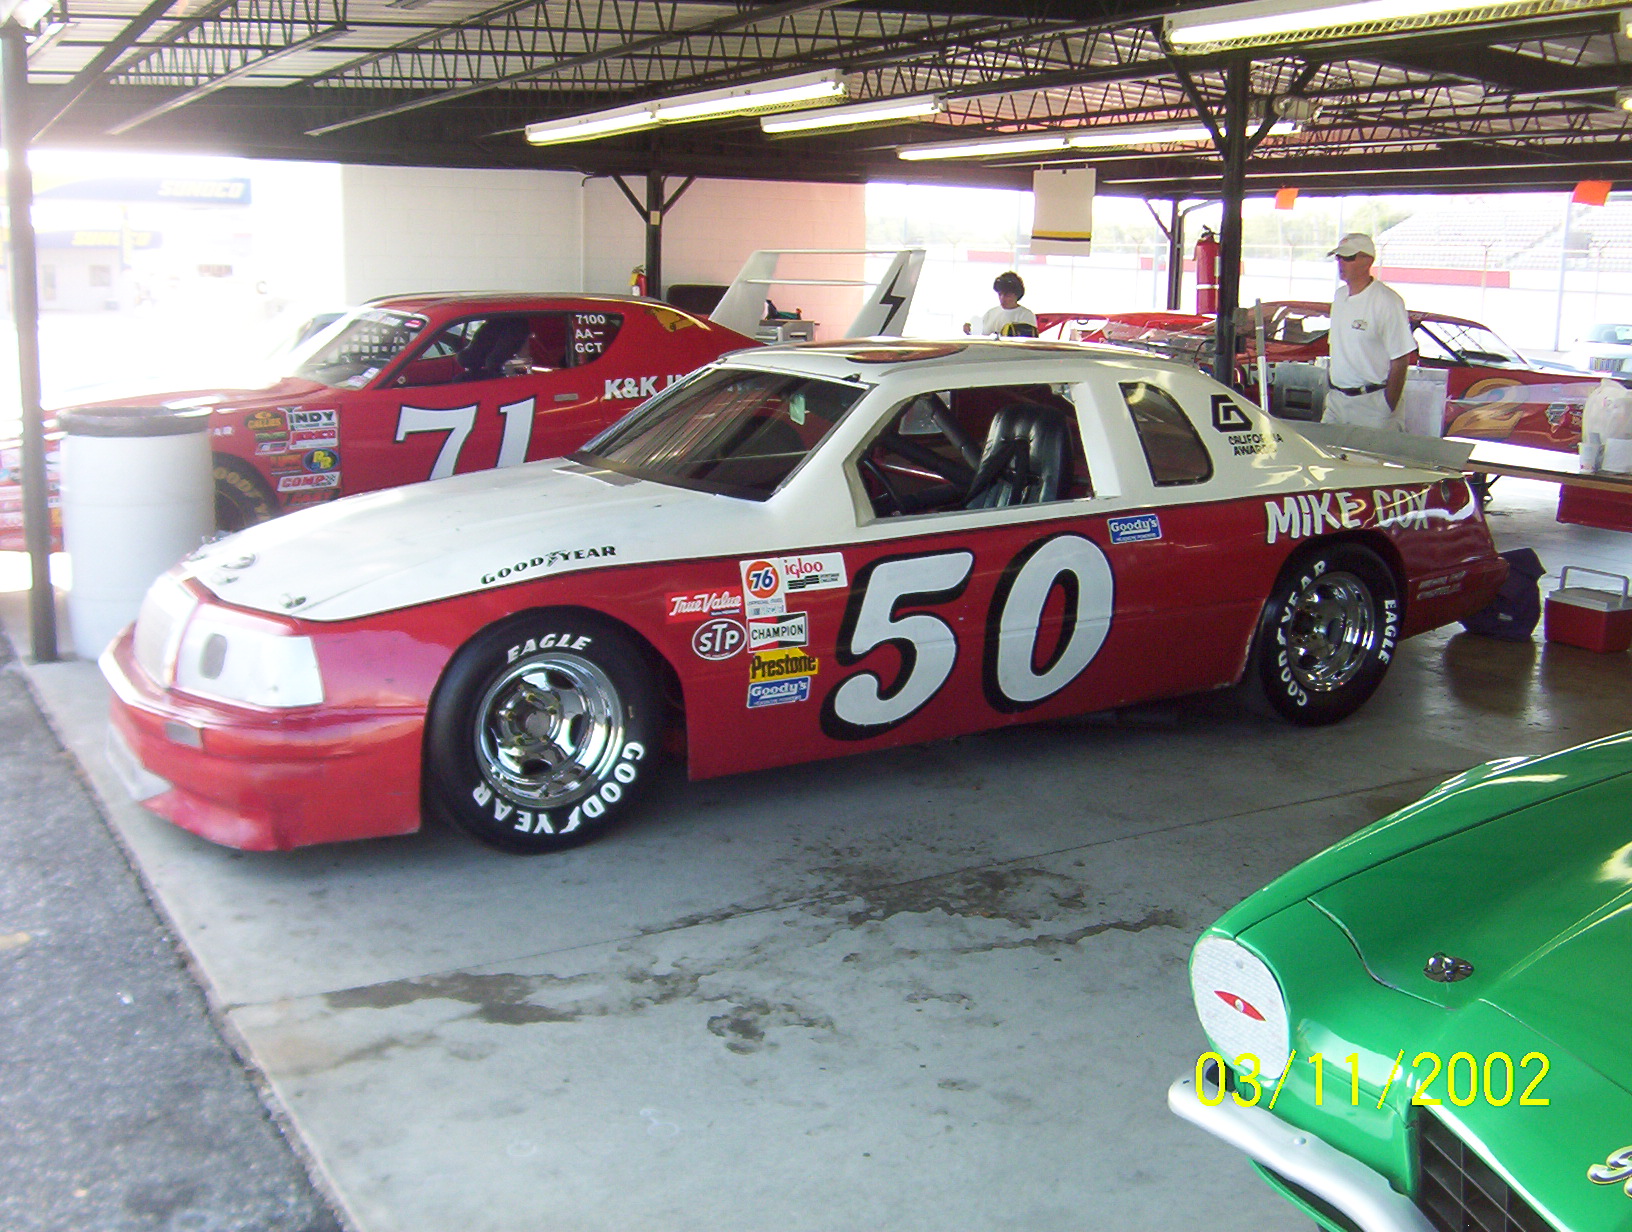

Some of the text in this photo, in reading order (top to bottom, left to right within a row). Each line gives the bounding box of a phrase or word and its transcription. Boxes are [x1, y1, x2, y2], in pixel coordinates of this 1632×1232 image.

[157, 180, 245, 198] SUNOCO
[575, 314, 606, 324] 7100
[575, 342, 603, 353] GCT
[604, 376, 658, 400] K&K
[287, 408, 335, 425] INDY
[395, 395, 536, 481] 71
[1228, 433, 1284, 446] CALIFORIA
[282, 475, 326, 488] COMP
[1373, 489, 1428, 530] COX
[1110, 518, 1158, 535] Goody's
[481, 545, 617, 585] GOODYEAR
[784, 557, 823, 578] igloo
[750, 567, 775, 591] 76
[699, 623, 740, 653] STP
[751, 624, 804, 641] CHAMPION
[824, 532, 1114, 735] 50
[1277, 560, 1326, 707] GOODYEAR
[1378, 600, 1397, 665] EAGLE
[507, 633, 592, 664] EAGLE
[751, 654, 817, 679] Prestone
[751, 681, 807, 699] Goody's
[472, 741, 645, 834] GOODYEAR
